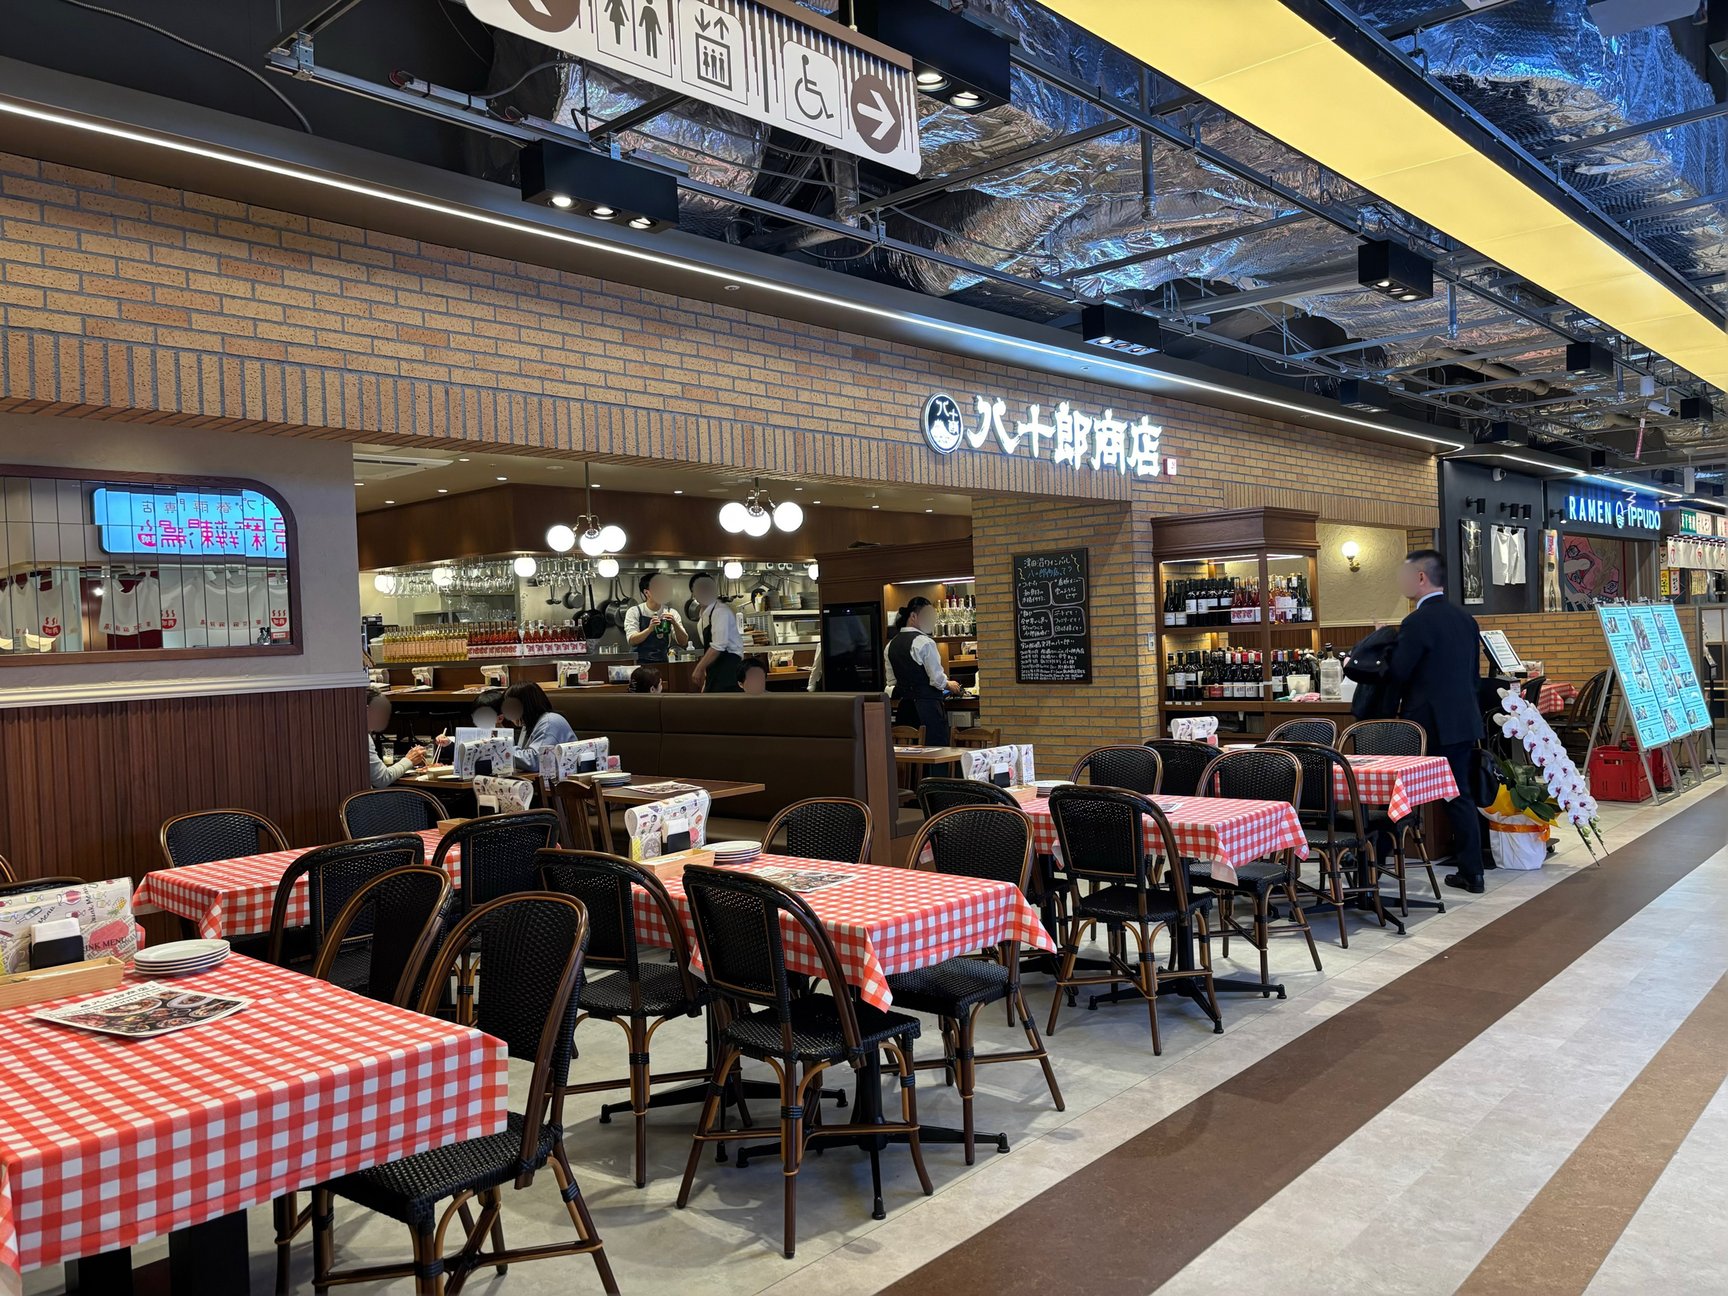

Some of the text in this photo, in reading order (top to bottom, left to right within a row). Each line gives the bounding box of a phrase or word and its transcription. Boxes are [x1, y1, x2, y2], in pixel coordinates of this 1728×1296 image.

[966, 395, 1162, 477] 八十郎商店
[1568, 495, 1612, 525] RAMEN
[1627, 504, 1661, 531] IPPUDO
[85, 941, 102, 951] INK
